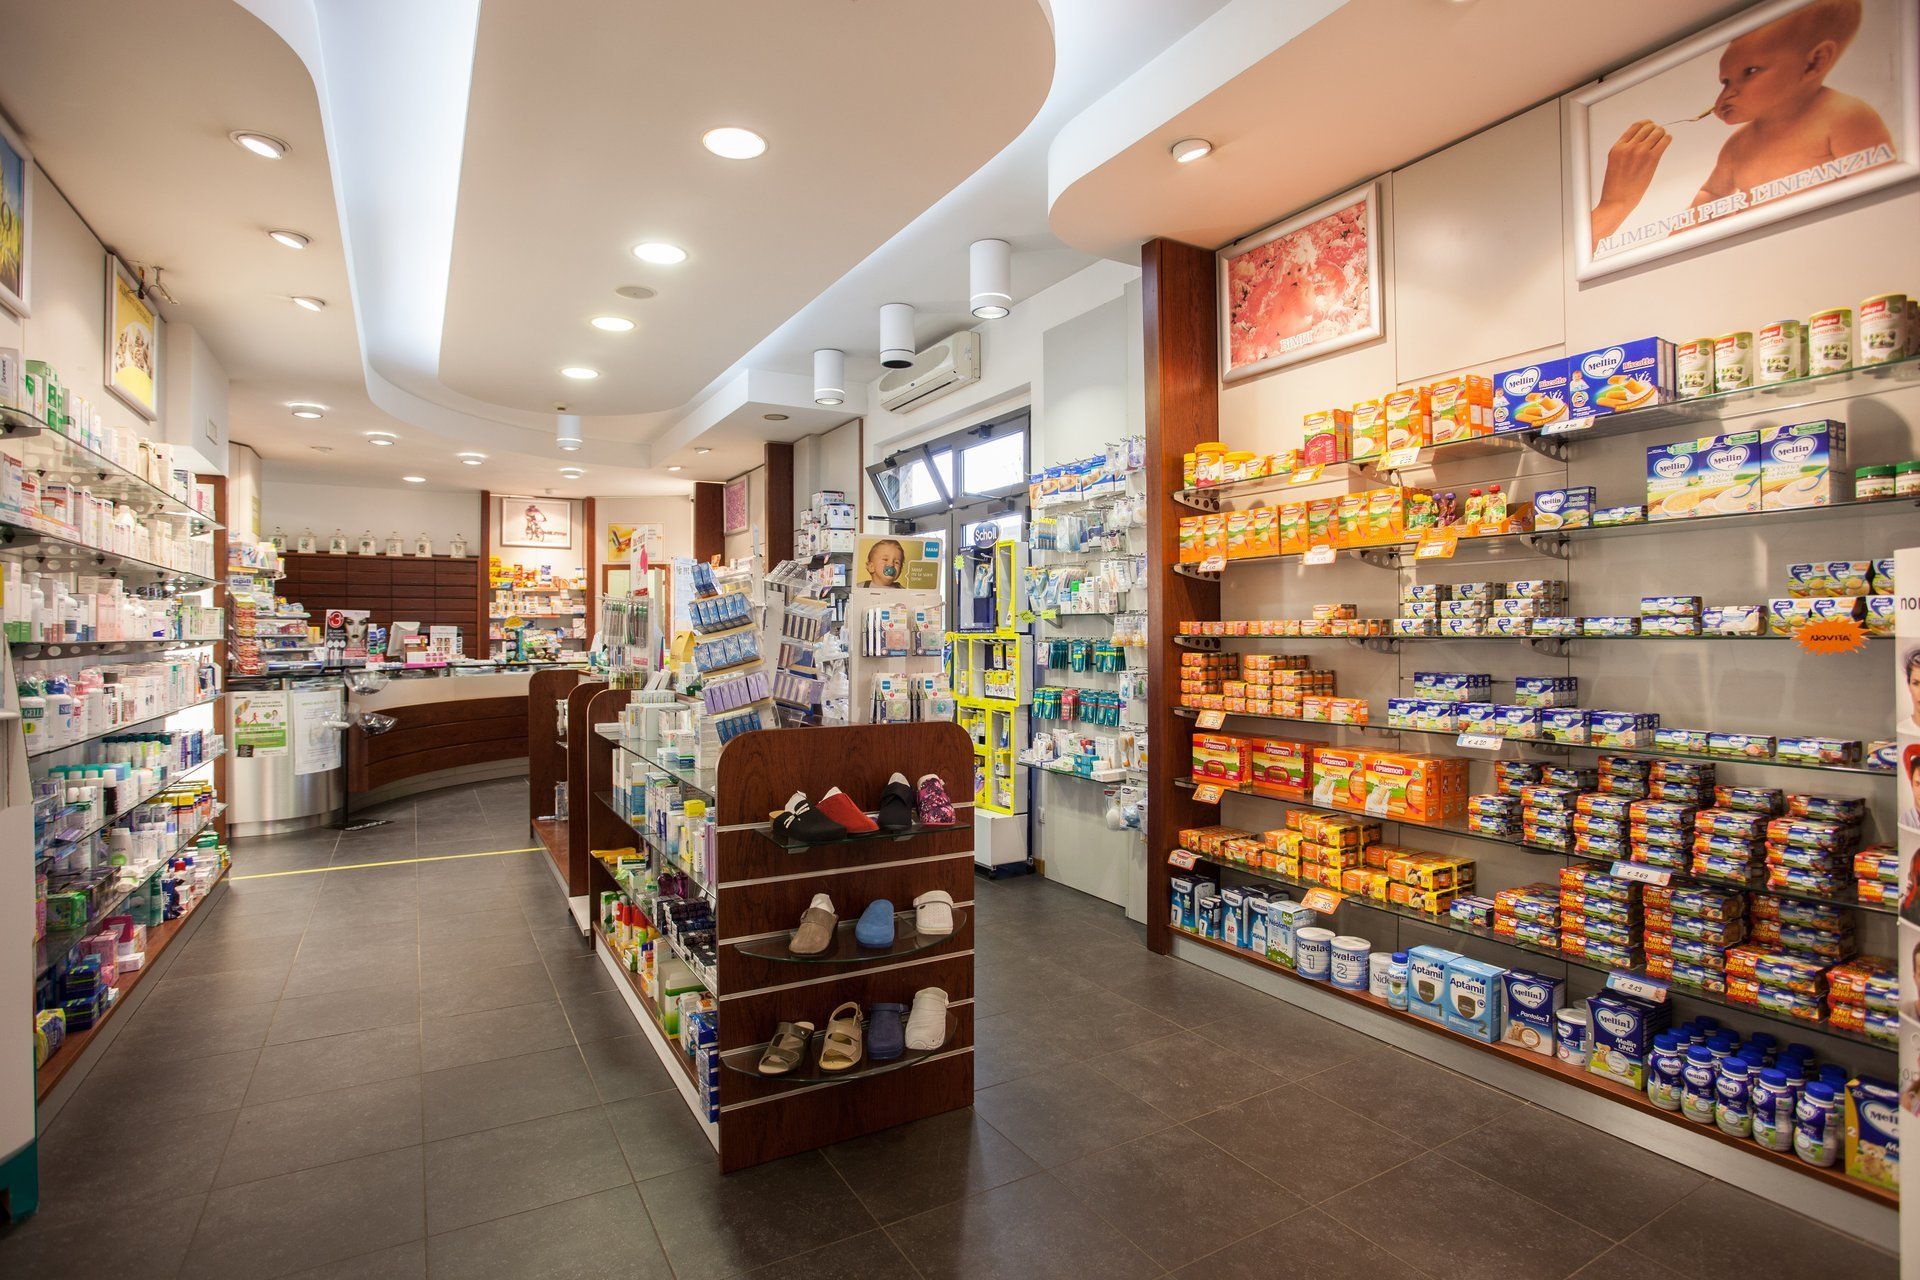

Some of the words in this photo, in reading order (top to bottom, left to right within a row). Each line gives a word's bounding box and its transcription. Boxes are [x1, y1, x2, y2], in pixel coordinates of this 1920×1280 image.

[1596, 209, 1696, 256] ALIMENTI
[1699, 193, 1748, 222] PER
[1750, 144, 1896, 204] L'INFANZIA
[1588, 357, 1617, 371] Mellin
[1508, 376, 1535, 389] Mellin
[1778, 444, 1809, 456] Mellin
[1712, 453, 1743, 465] Mellin
[1659, 462, 1686, 473] Mellin
[1541, 497, 1562, 506] Mellin
[975, 528, 997, 541] Scholl
[1900, 597, 1920, 610] no
[1376, 766, 1404, 776] Plasmon
[1307, 955, 1315, 970] 1
[1332, 950, 1362, 962] ovalac
[1337, 962, 1348, 979] 2
[1411, 962, 1444, 980] Aptamil
[1450, 977, 1486, 995] Aptamil
[1477, 1021, 1489, 1034] 2
[1616, 1037, 1637, 1047] Mellin
[1618, 1044, 1635, 1053] UNO
